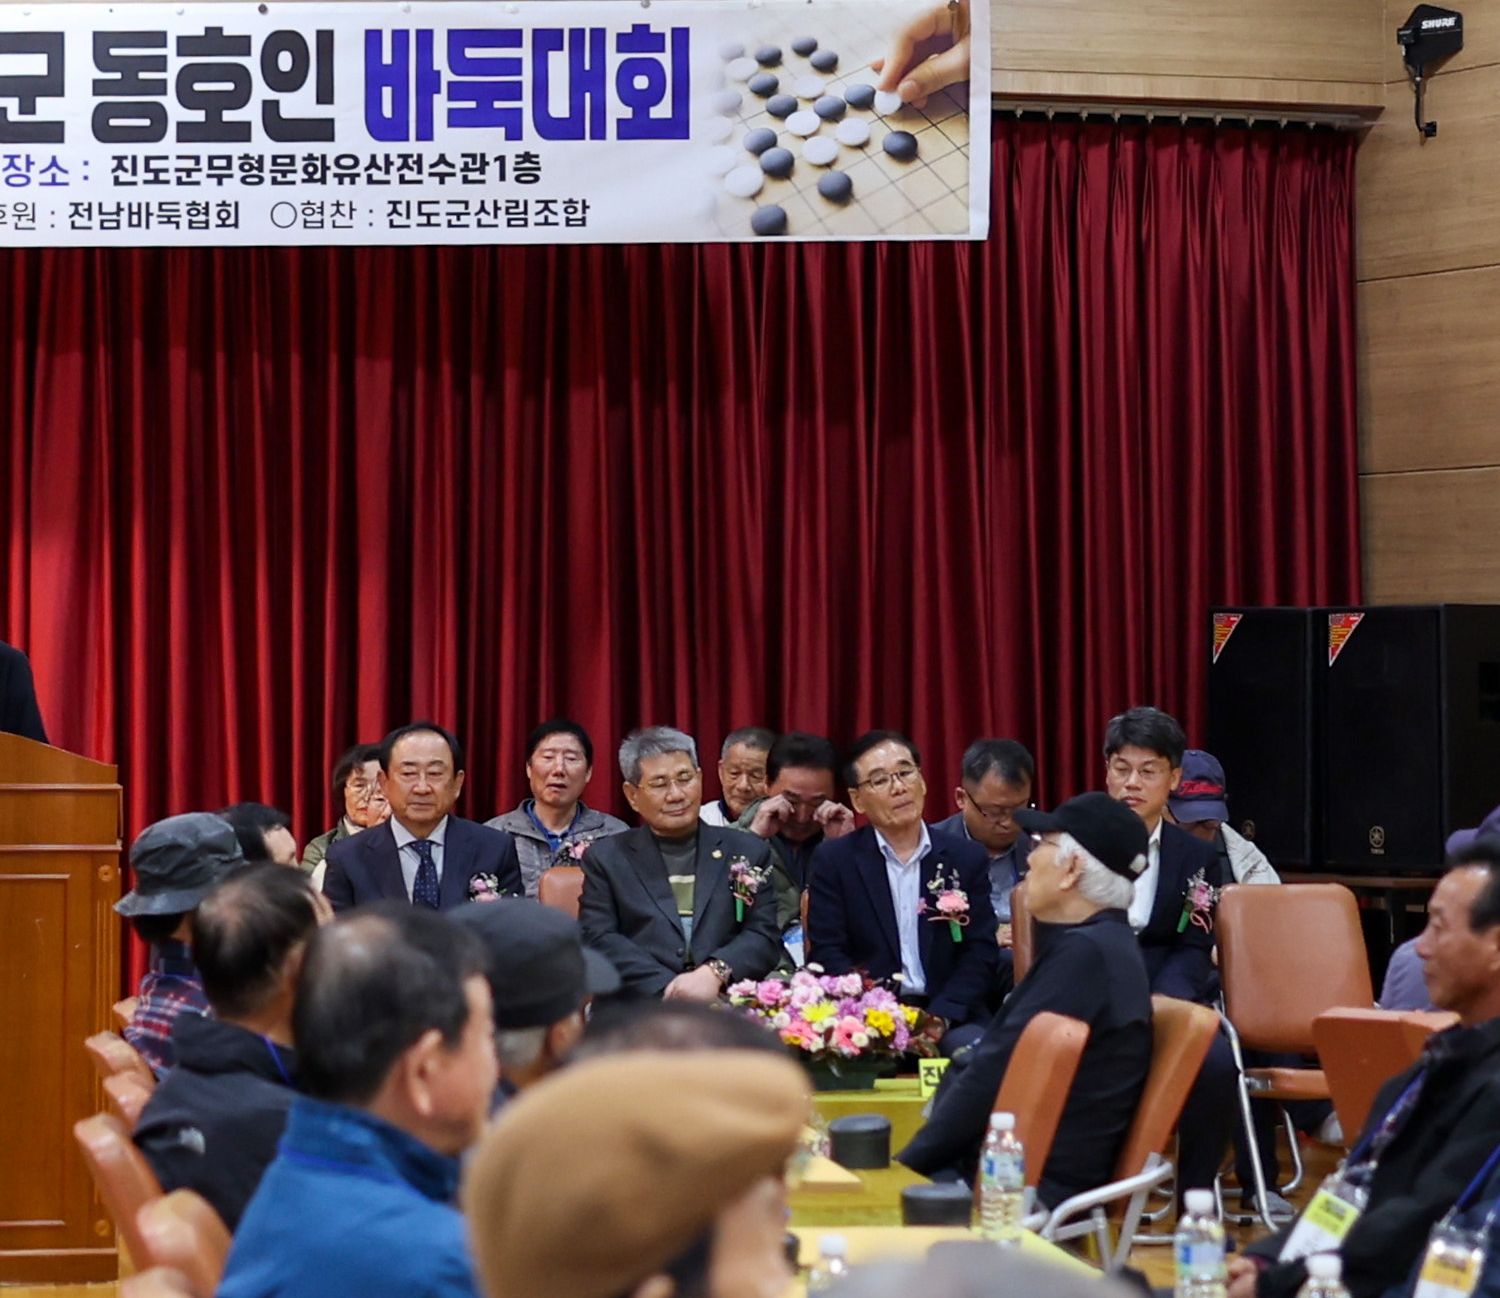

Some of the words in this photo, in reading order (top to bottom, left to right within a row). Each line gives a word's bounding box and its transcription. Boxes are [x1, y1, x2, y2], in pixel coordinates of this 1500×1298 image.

[1421, 16, 1457, 30] SHURE
[91, 26, 336, 144] 동호인
[364, 23, 691, 142] 바둑대회
[2, 154, 70, 188] 장소
[110, 151, 542, 187] 진도군무형문화유산전수관1층
[68, 200, 241, 230] 전남바둑협회
[385, 198, 591, 229] 진도군산림조합
